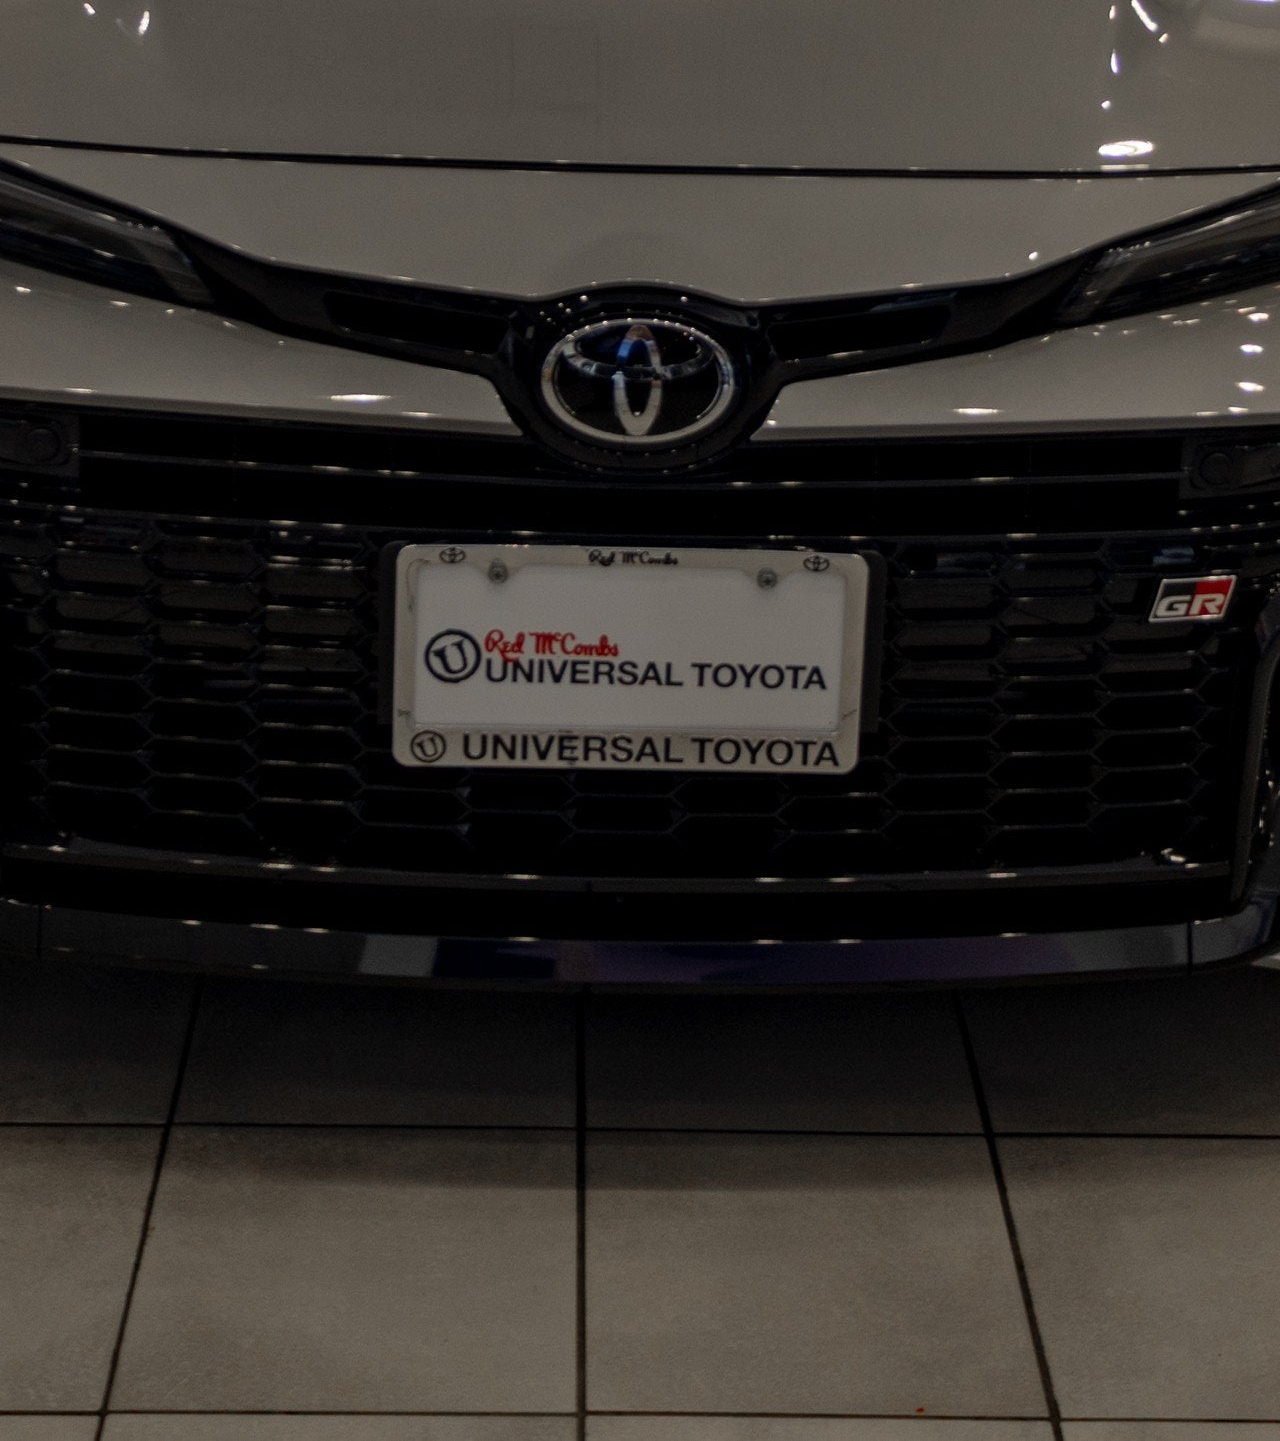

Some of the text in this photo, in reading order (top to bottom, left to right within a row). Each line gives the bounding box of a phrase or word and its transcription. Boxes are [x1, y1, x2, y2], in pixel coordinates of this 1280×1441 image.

[1156, 593, 1225, 617] GR
[484, 629, 618, 662] Red McCombs
[486, 658, 827, 690] UNIVERSAL TOYOTA
[463, 733, 840, 767] UNIVERSAL TOYOTA
